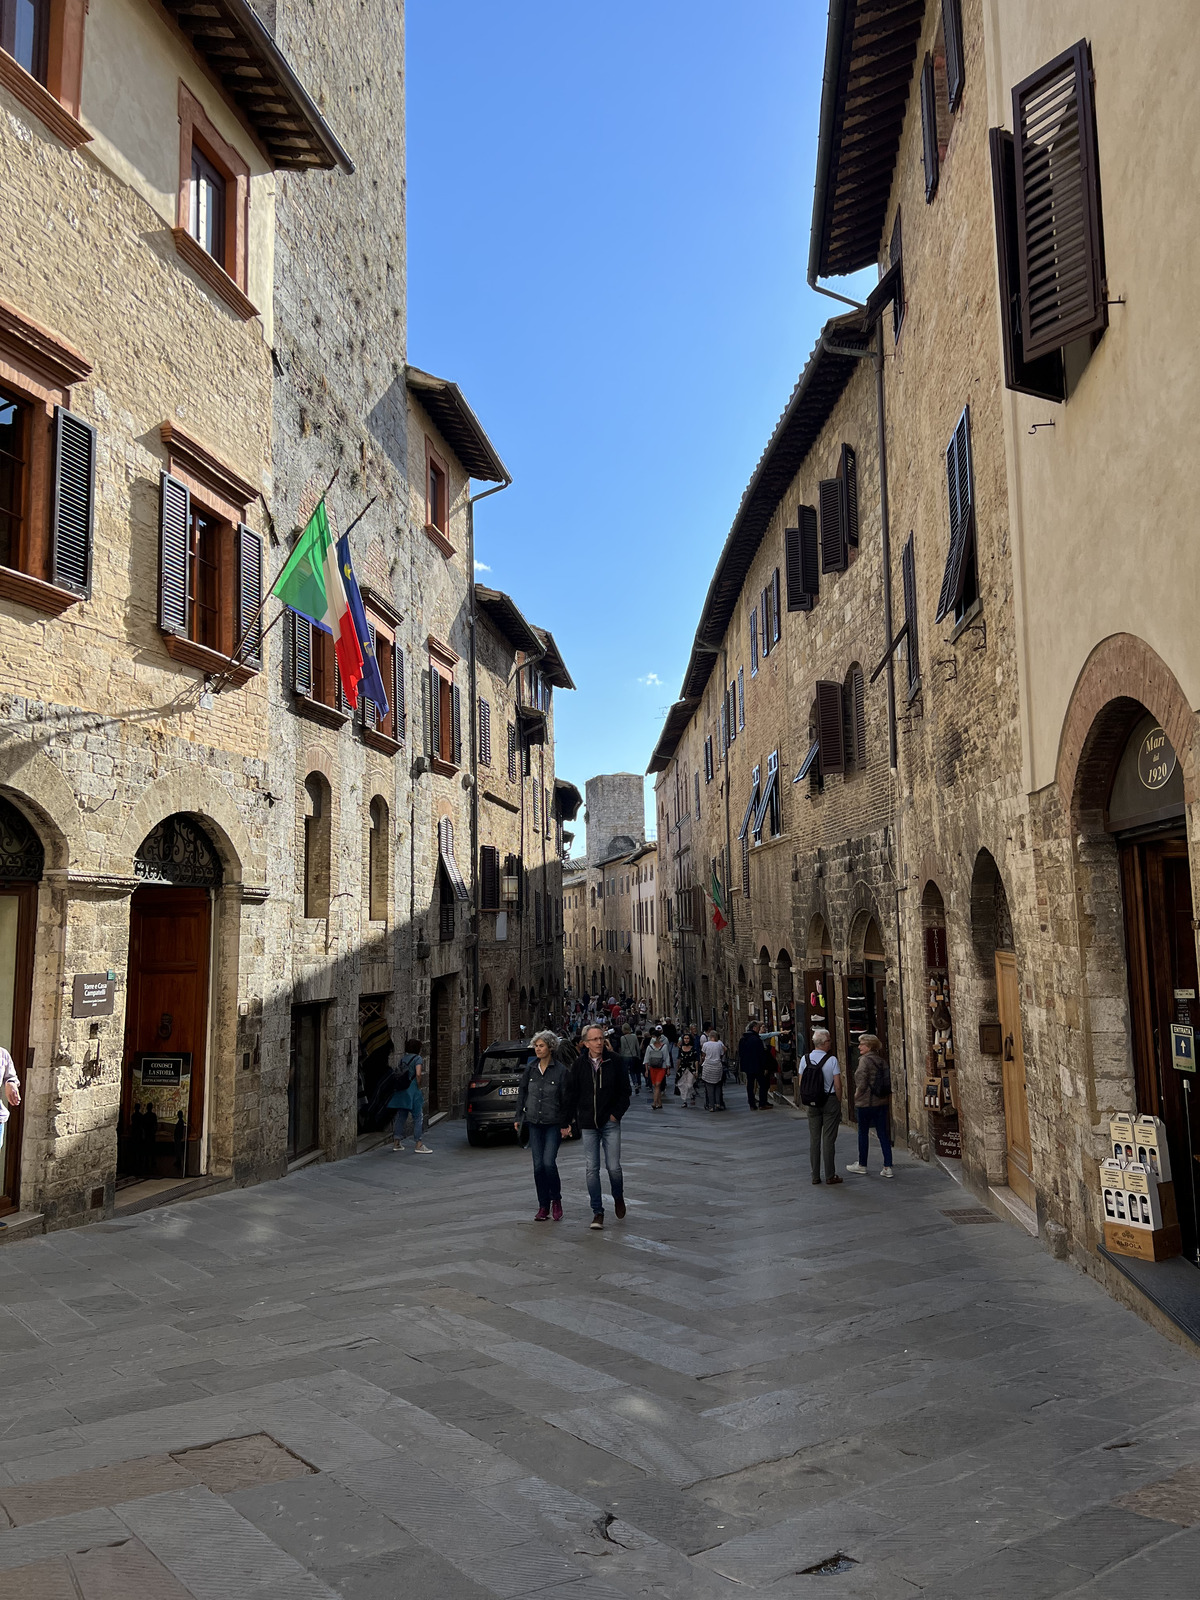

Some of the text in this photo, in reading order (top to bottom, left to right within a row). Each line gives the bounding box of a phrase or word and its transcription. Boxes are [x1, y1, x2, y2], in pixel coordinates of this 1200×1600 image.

[1146, 732, 1165, 754] Mari
[1147, 762, 1167, 783] 1920
[932, 928, 940, 967] TAGLIERI
[1174, 1026, 1192, 1035] ENTRATA
